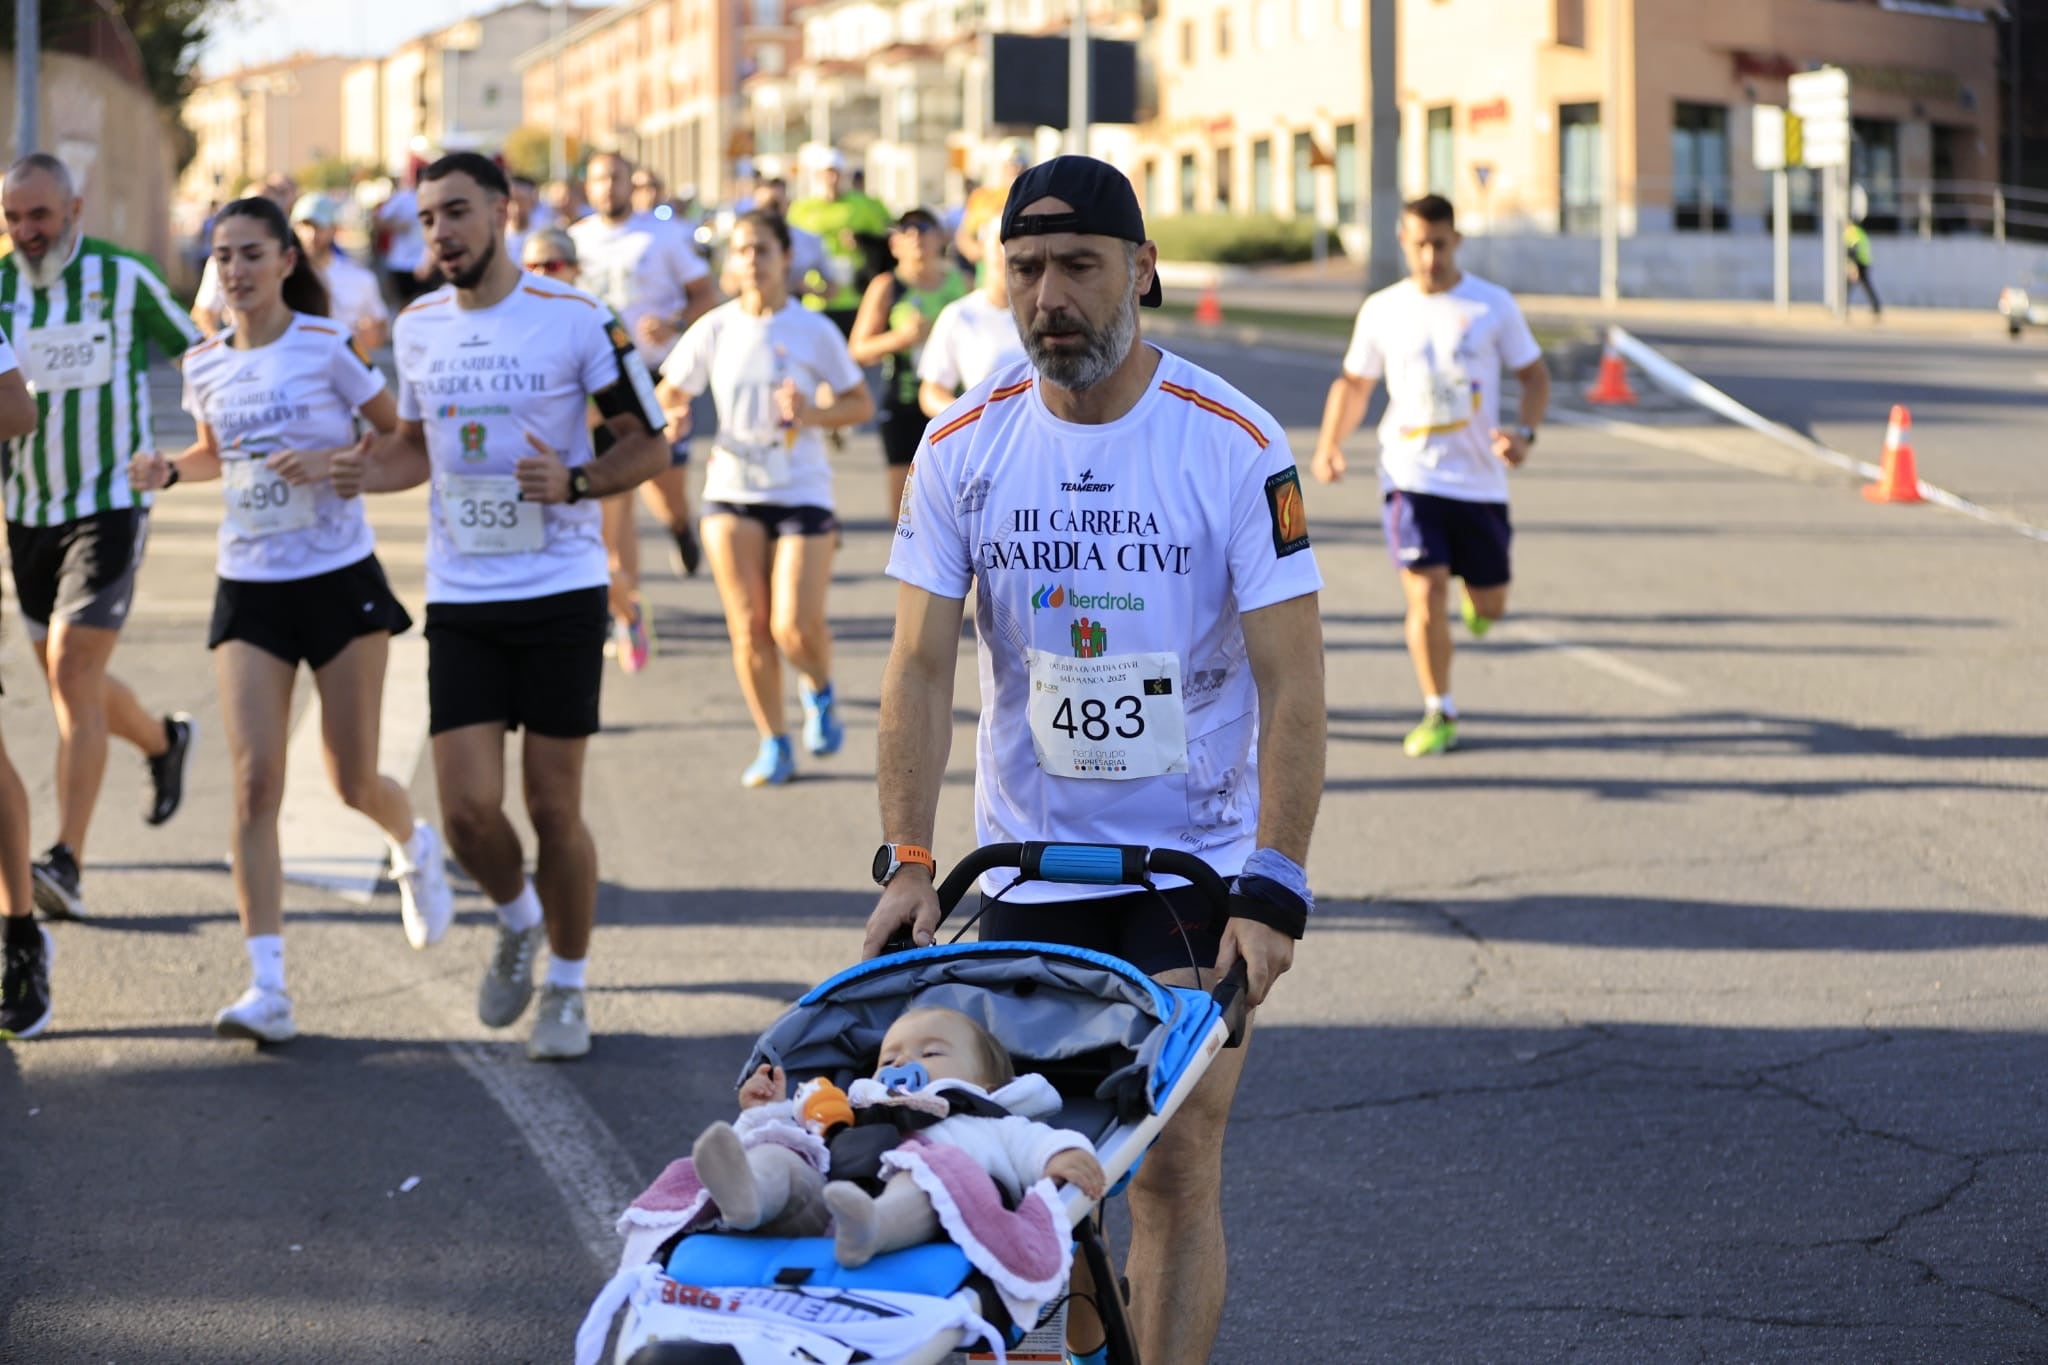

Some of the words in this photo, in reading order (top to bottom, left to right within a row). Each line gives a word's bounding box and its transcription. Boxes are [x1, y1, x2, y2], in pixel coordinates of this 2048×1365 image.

[46, 343, 95, 370] 289
[491, 374, 547, 392] CIVIL
[239, 480, 290, 512] 490
[1060, 482, 1116, 493] TEAMERGY
[459, 498, 518, 529] 353
[1013, 508, 1040, 533] III
[1050, 509, 1161, 537] CARRERA
[1117, 543, 1193, 576] CIVIL
[1068, 587, 1145, 612] Iberdrola
[1052, 695, 1145, 741] 483
